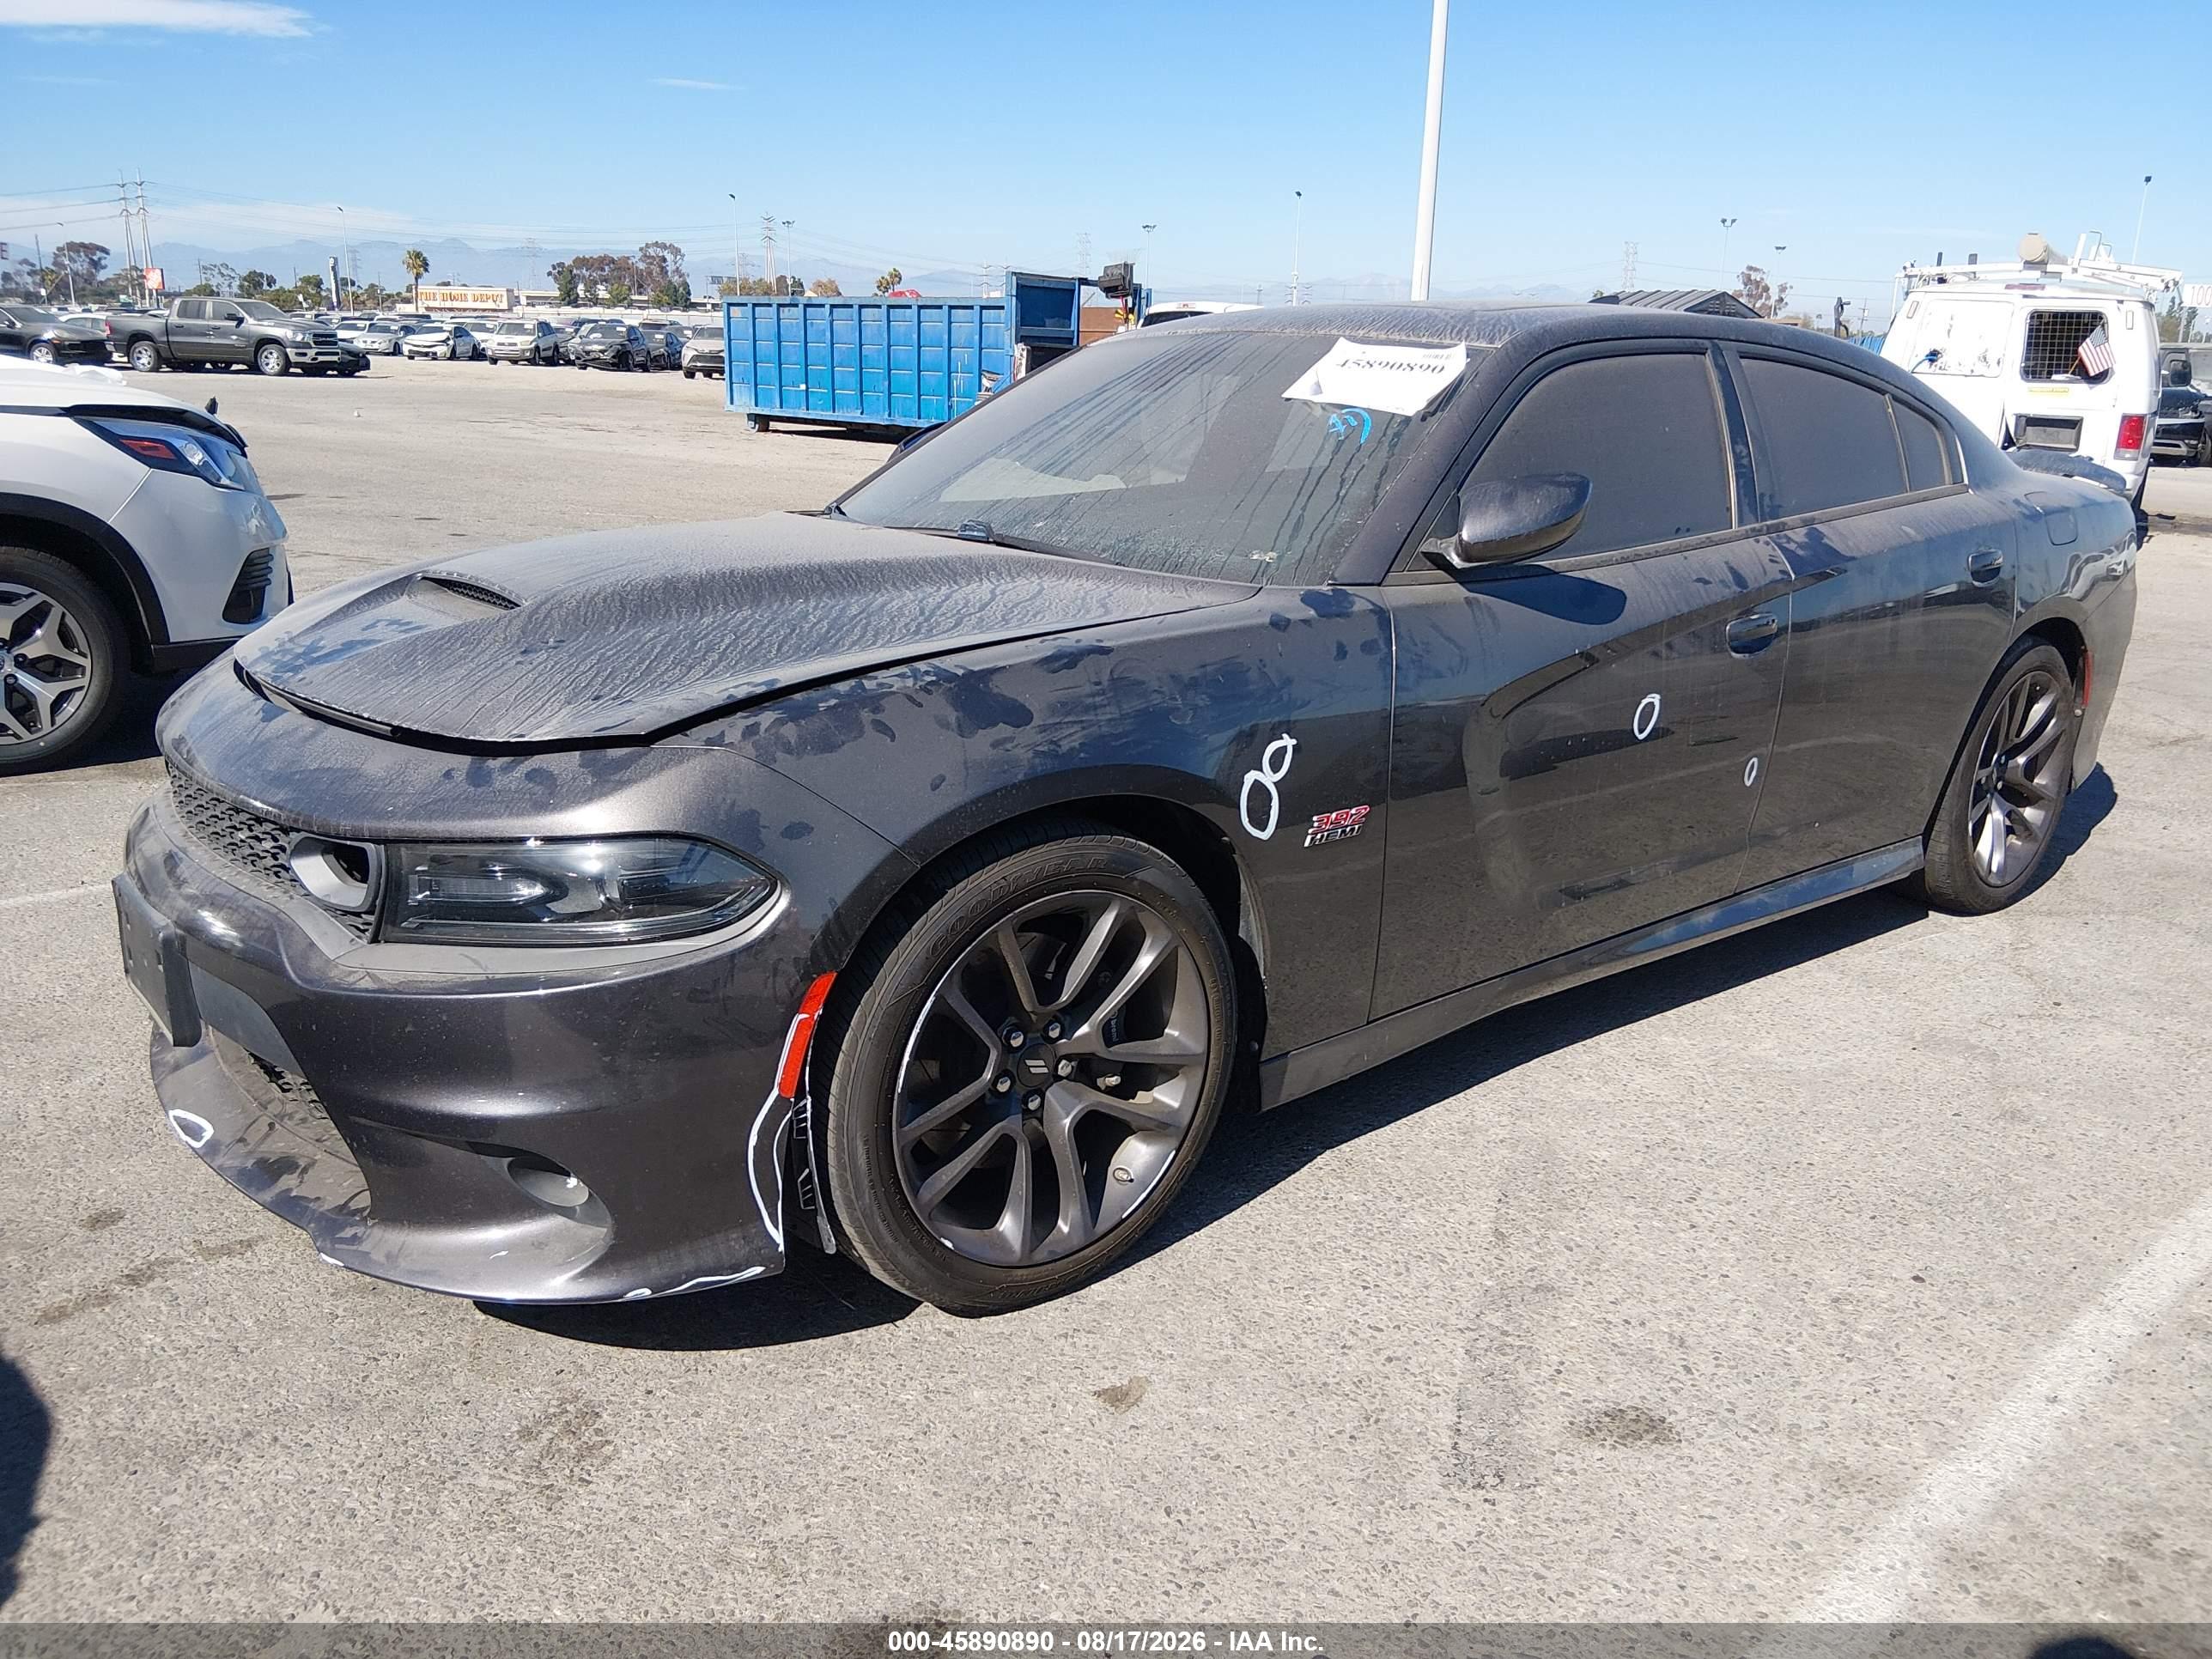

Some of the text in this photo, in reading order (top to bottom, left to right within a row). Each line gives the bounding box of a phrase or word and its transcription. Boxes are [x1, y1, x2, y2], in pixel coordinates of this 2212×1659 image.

[418, 292, 438, 301] THE
[471, 292, 504, 303] DEPOT
[1335, 357, 1446, 375] 45890890
[1309, 805, 1370, 834] 392
[1304, 823, 1364, 848] HEMI
[930, 857, 1108, 957] GOODYEAR
